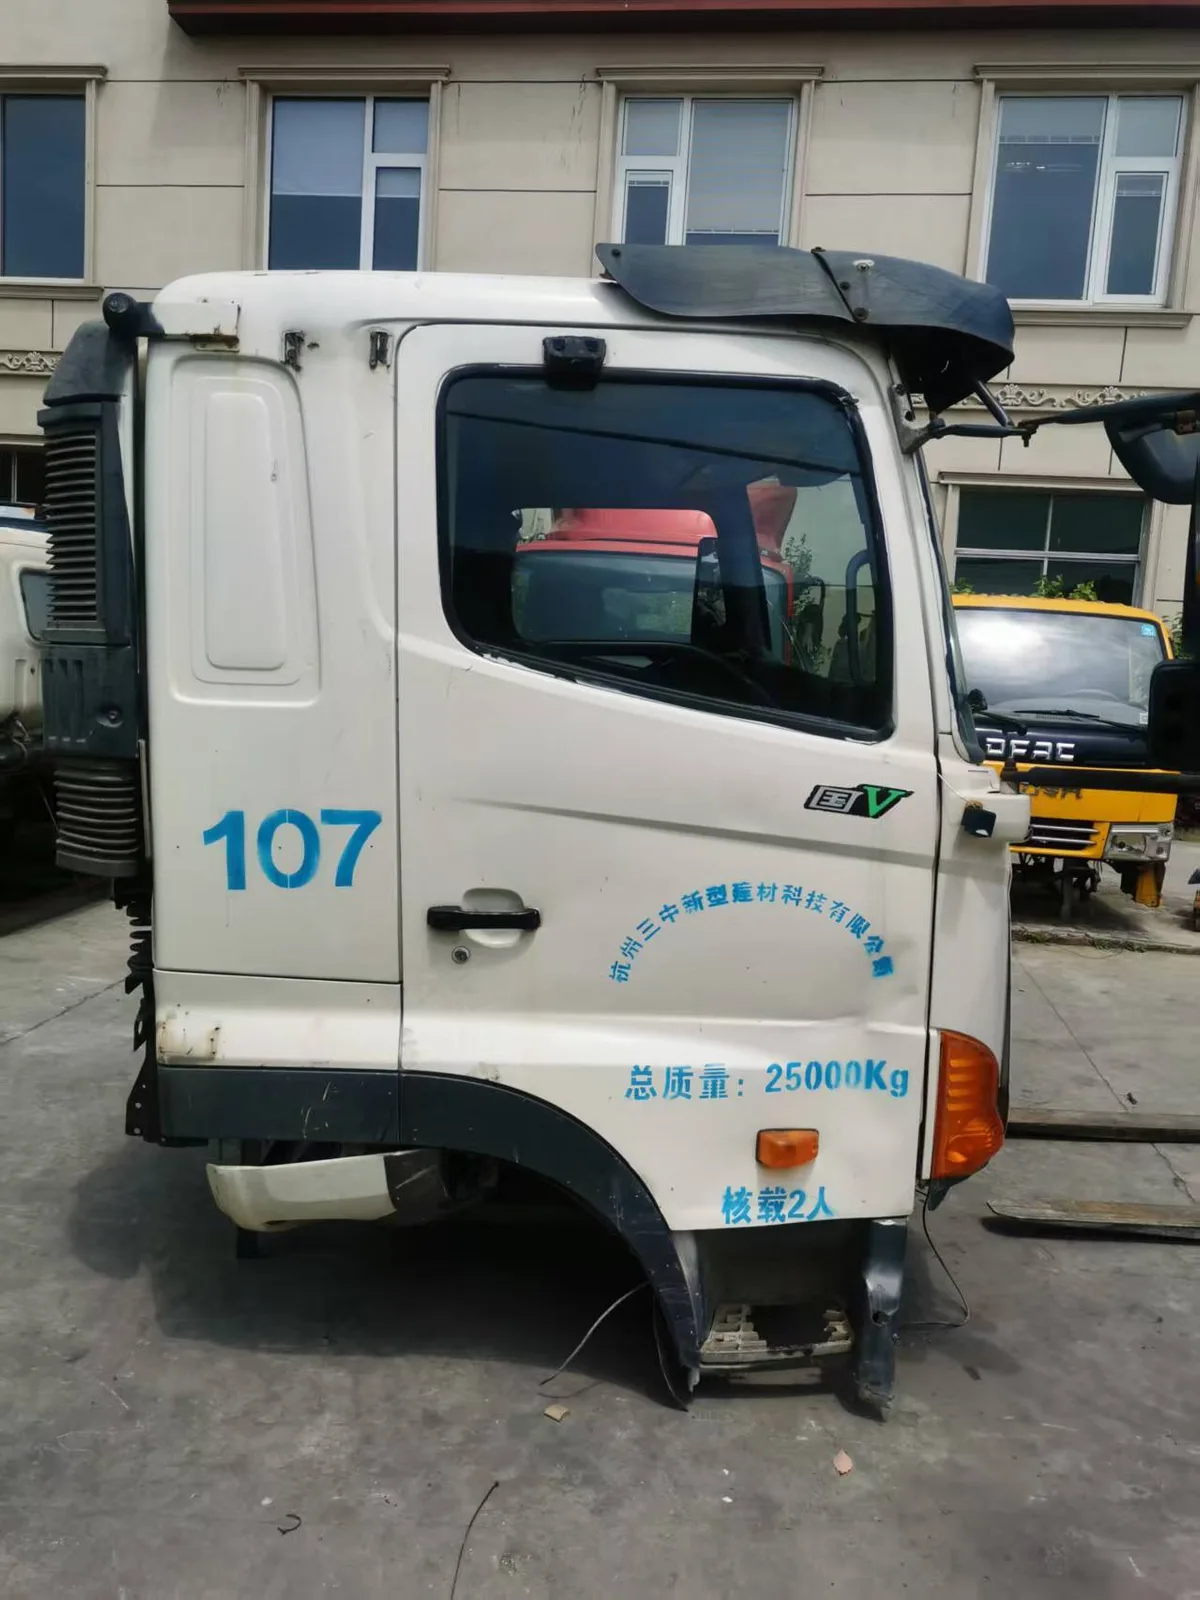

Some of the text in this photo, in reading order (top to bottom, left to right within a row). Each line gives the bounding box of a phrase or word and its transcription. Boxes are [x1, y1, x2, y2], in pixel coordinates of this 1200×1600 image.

[202, 808, 383, 891] 107
[720, 1184, 836, 1225] 核载2人
